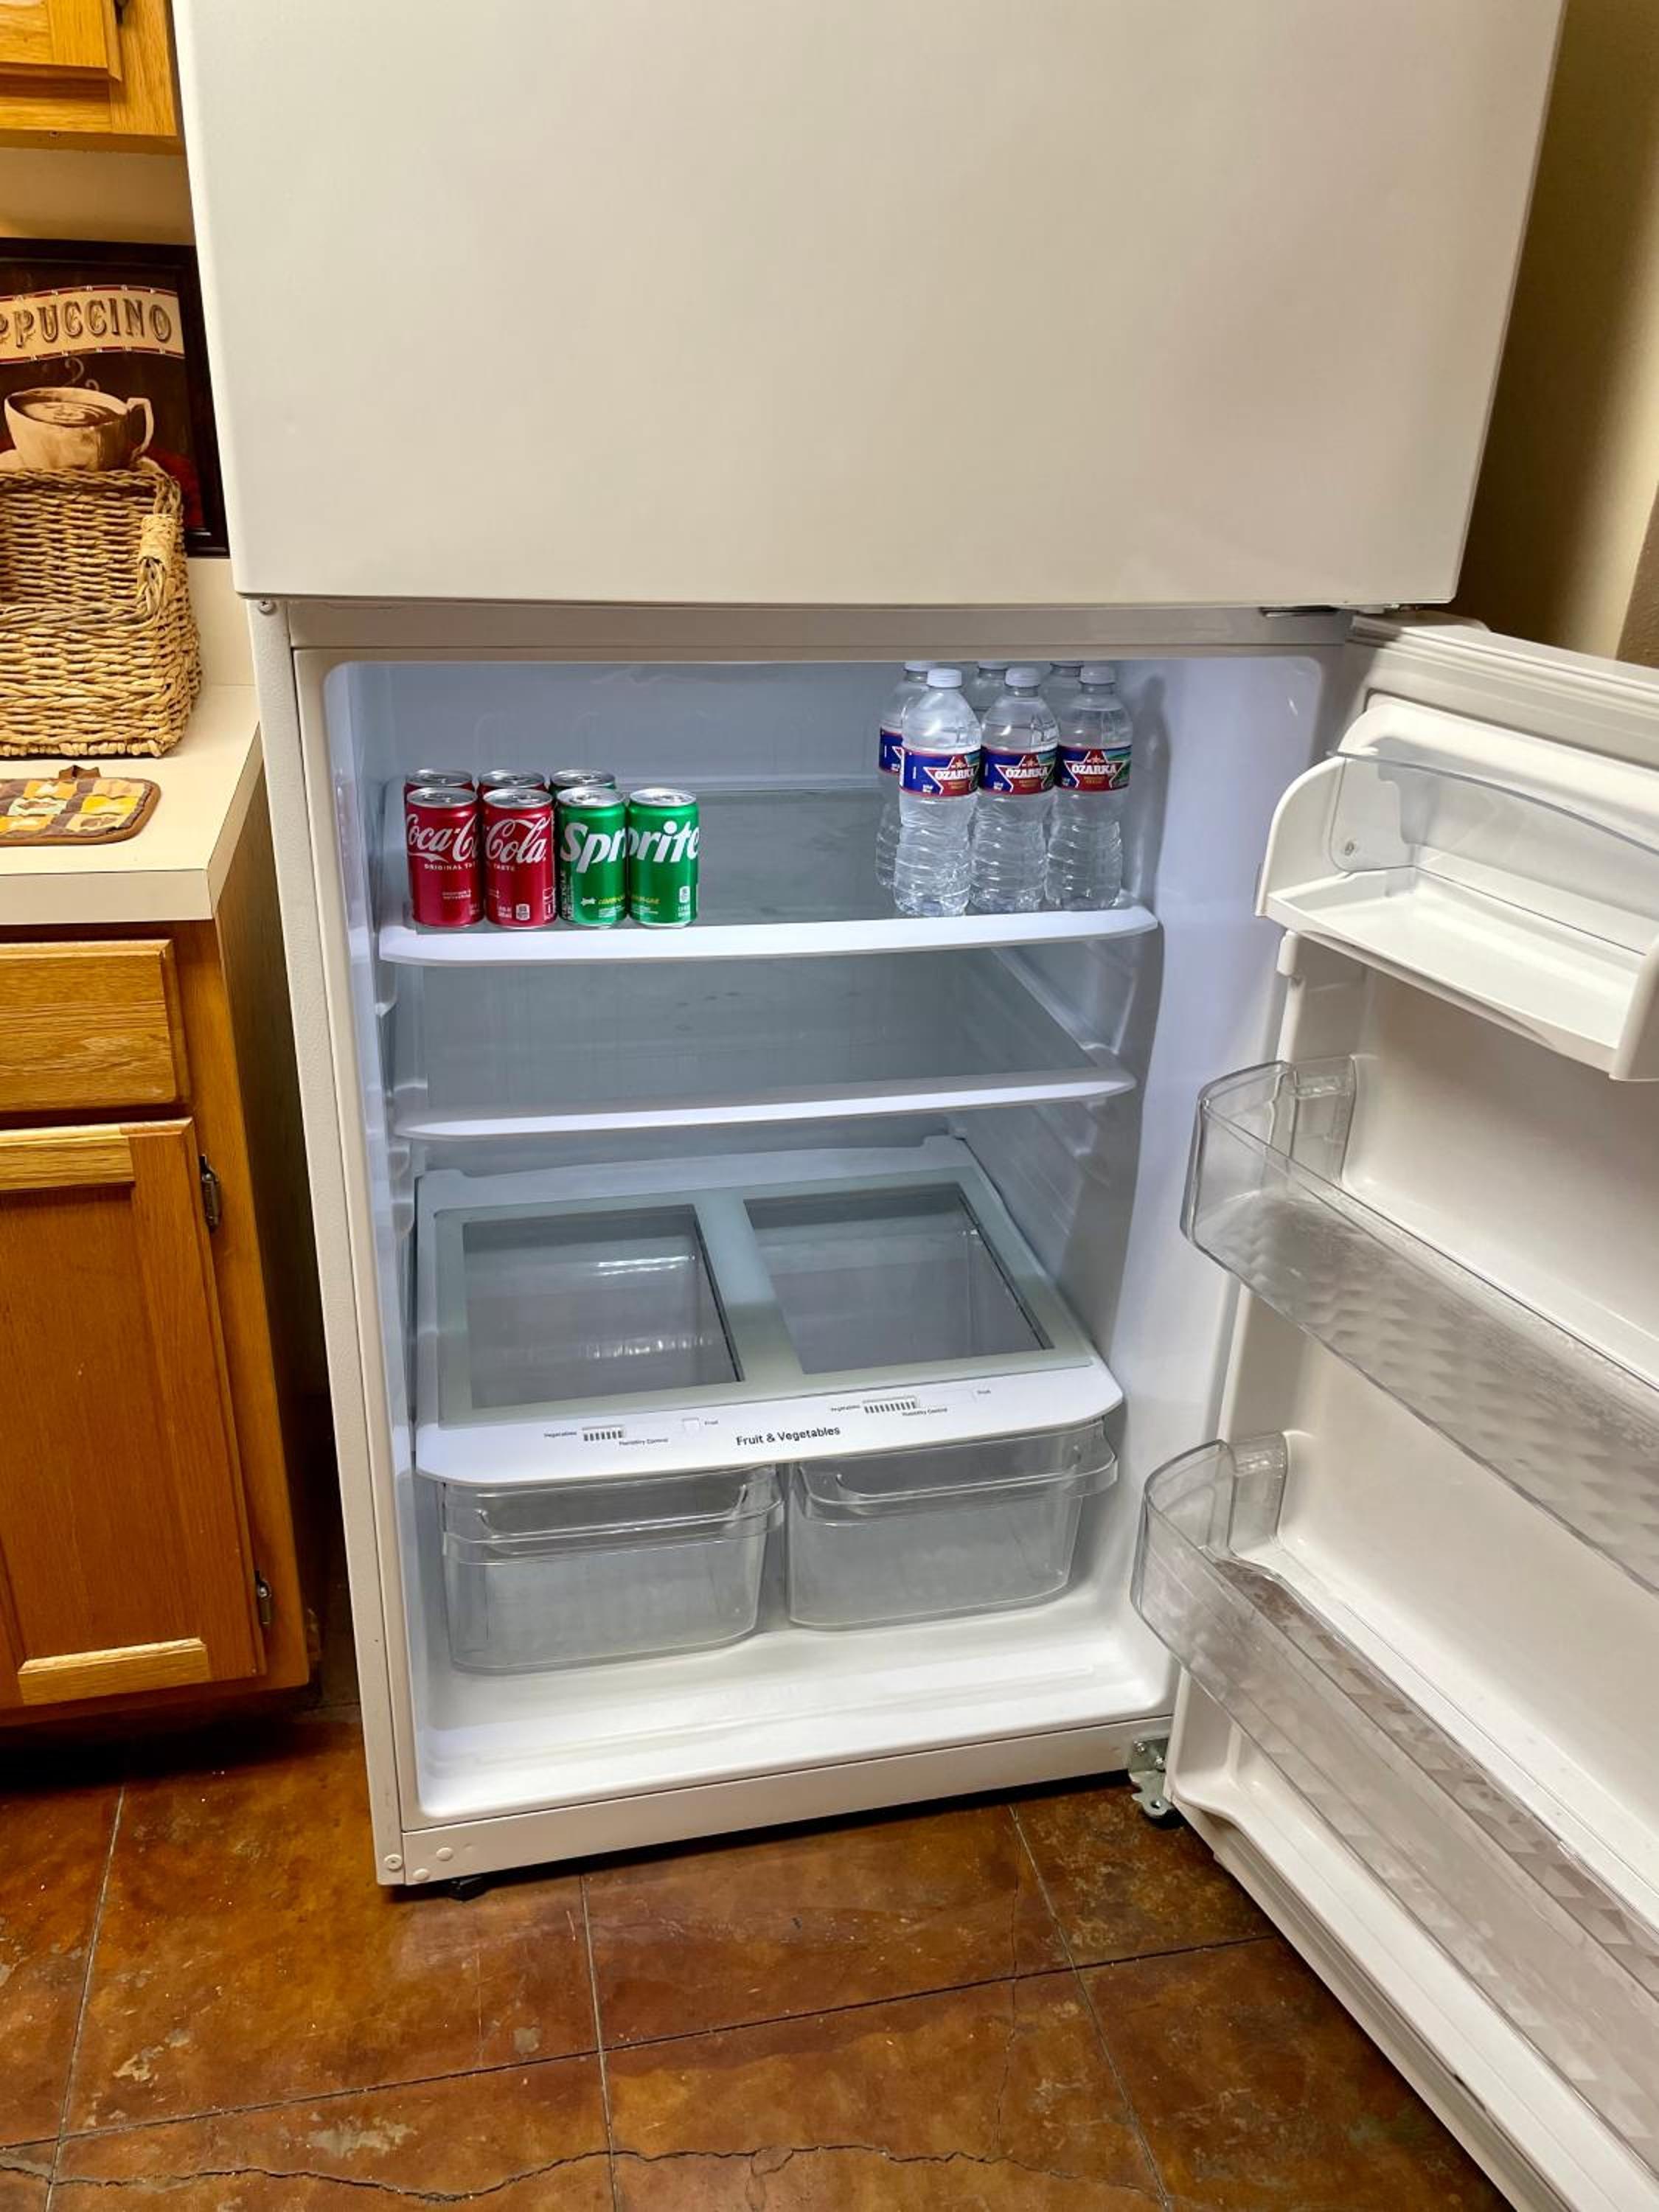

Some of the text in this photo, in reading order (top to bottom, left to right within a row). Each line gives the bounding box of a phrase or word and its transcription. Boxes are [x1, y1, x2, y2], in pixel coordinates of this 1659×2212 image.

[1005, 765, 1048, 779] OZARKA
[1071, 762, 1117, 775] OZARKA
[736, 1426, 841, 1446] Fruit & Vegetables
